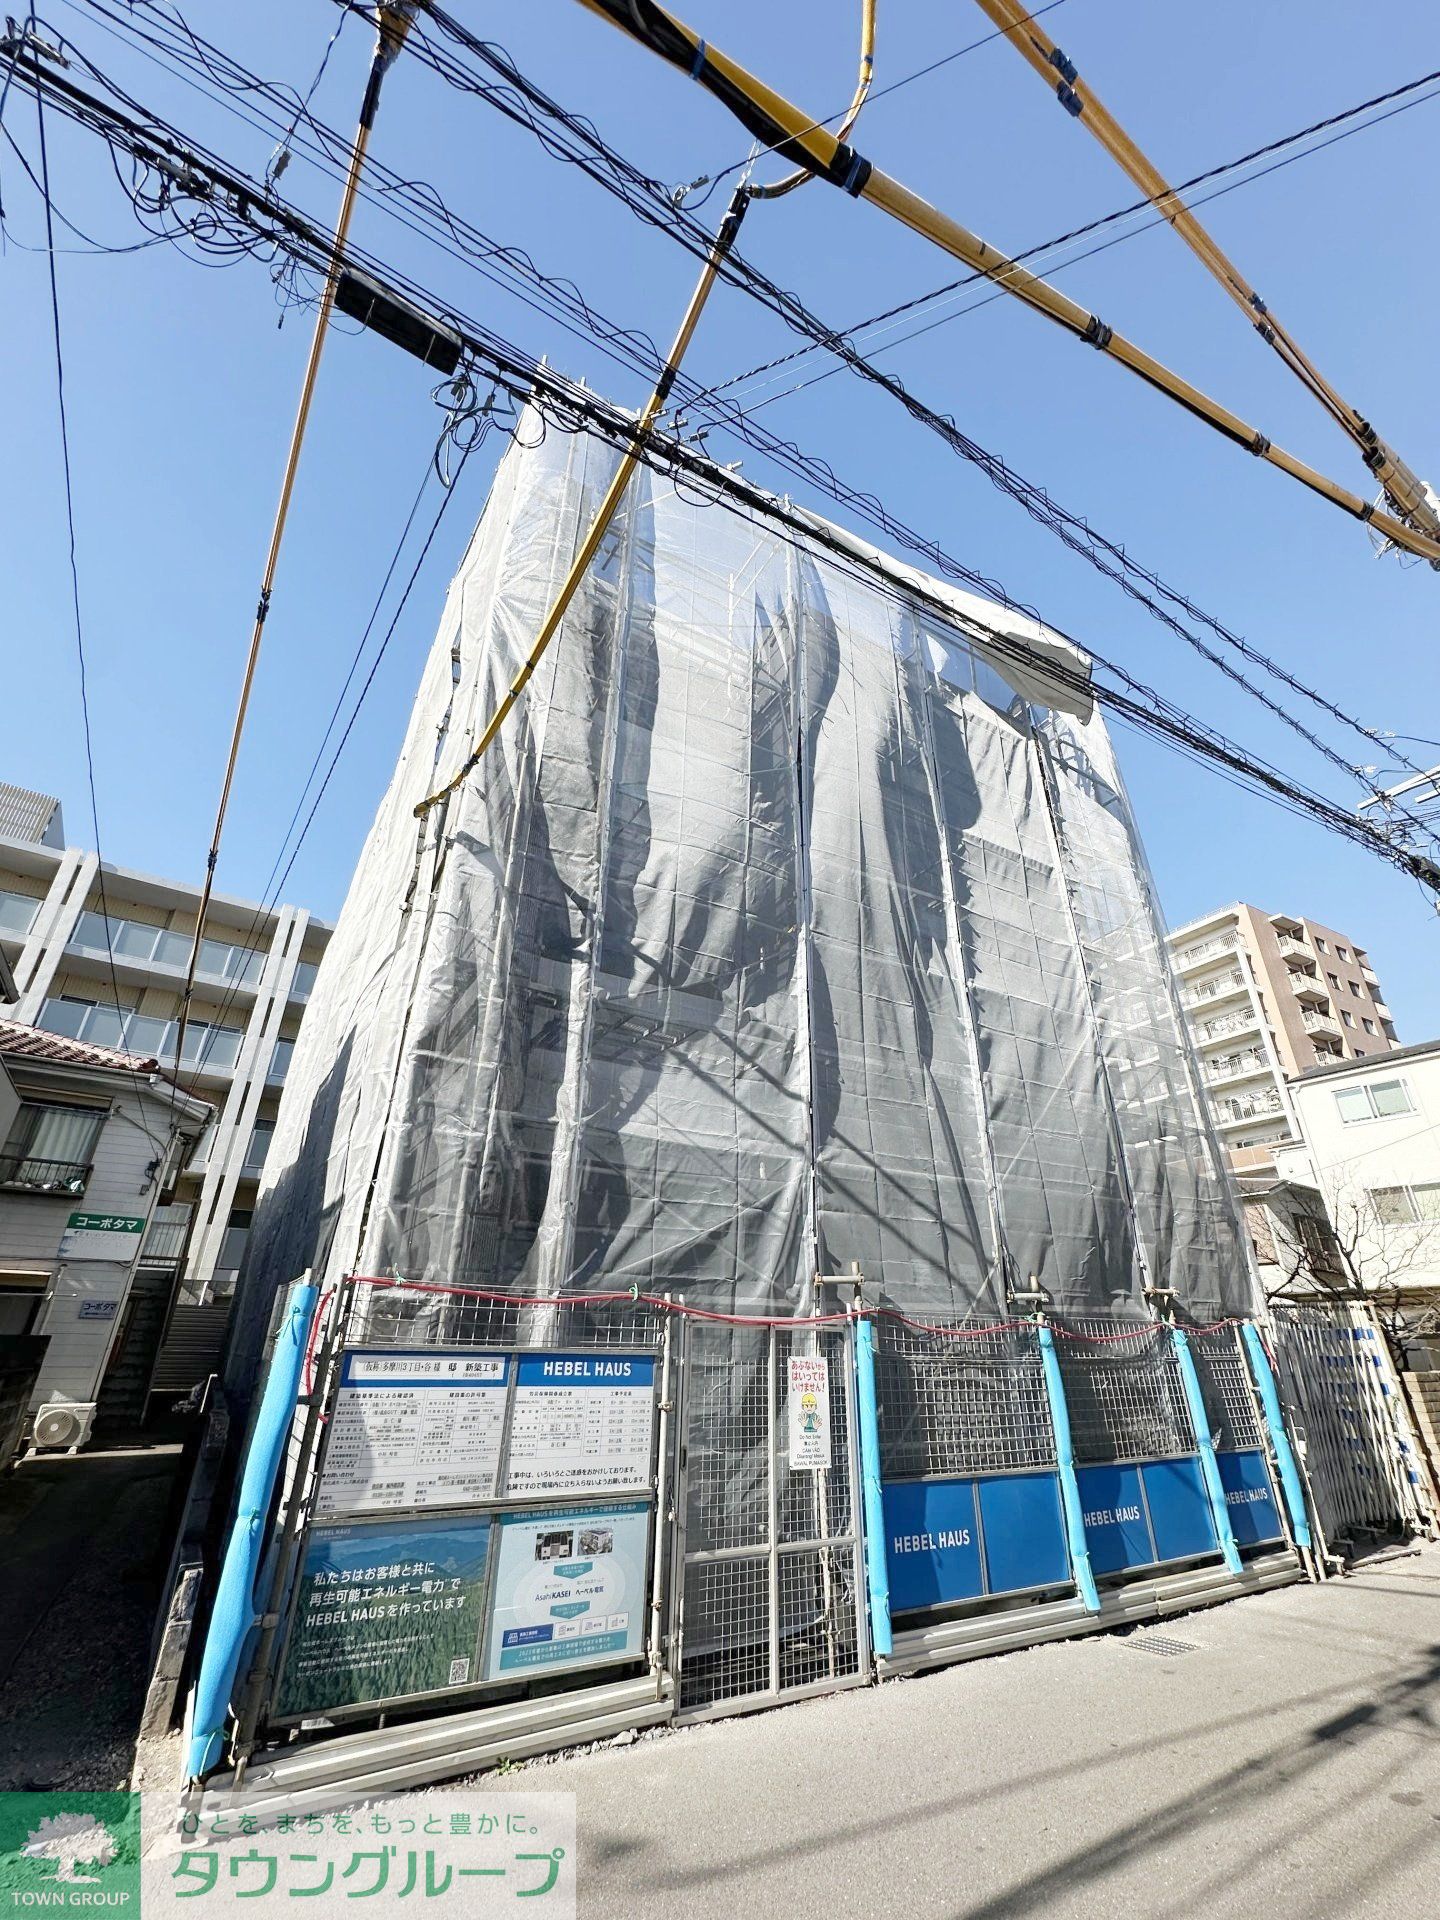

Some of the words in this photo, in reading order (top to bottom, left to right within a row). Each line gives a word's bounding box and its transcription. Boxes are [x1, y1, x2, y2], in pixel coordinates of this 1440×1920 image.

[76, 1217, 138, 1230] コーポタマ
[448, 1363, 457, 1372] 邸
[465, 1363, 499, 1371] 新築工事
[543, 1361, 591, 1376] HEBEL
[595, 1362, 632, 1376] HAUS
[791, 1361, 825, 1370] あぶないから
[791, 1372, 825, 1381] はいっては
[1226, 1491, 1248, 1505] HEBEL
[1248, 1487, 1268, 1501] HAUS
[1084, 1513, 1115, 1527] HEBEL
[1115, 1505, 1140, 1521] HAUS
[894, 1533, 937, 1554] HEBEL
[938, 1529, 970, 1548] HAUS
[313, 1562, 436, 1586] 私たちはお客様と共に
[305, 1611, 348, 1628] HEBEL
